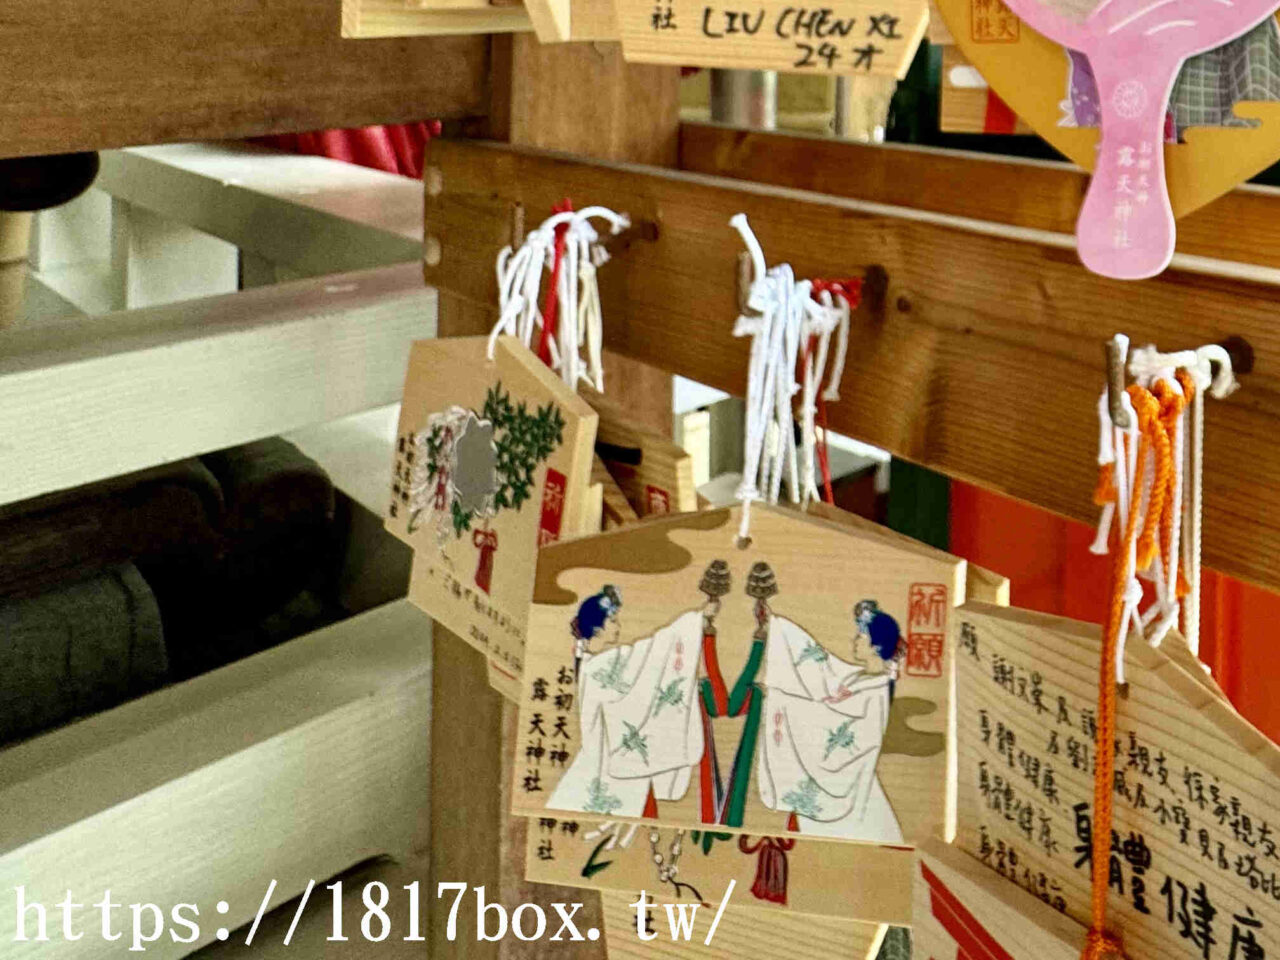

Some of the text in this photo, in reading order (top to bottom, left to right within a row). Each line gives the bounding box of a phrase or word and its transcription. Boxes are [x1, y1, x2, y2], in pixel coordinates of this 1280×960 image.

[776, 8, 854, 38] CHEN
[523, 677, 549, 793] 露天神社
[549, 664, 575, 767] お初天神
